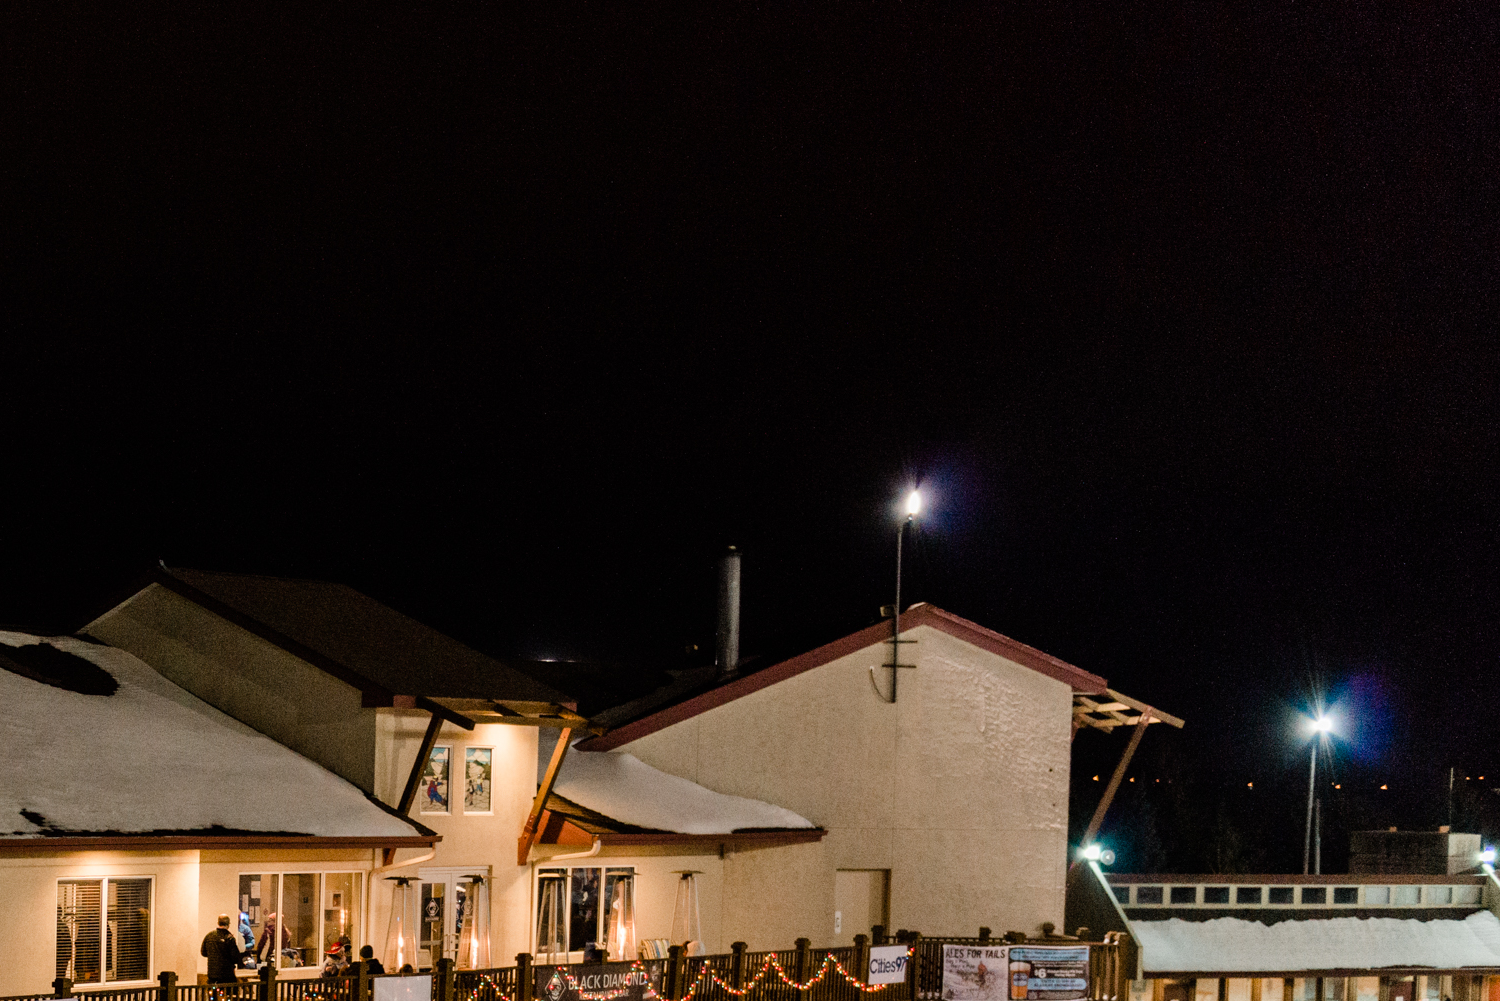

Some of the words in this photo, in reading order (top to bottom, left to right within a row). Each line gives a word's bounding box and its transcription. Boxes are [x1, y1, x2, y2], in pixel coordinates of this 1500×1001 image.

[967, 949, 982, 959] FOR
[985, 949, 1006, 959] TAILS
[870, 956, 907, 974] Cities97
[568, 975, 601, 990] BLACK
[603, 971, 648, 989] DIAMOND
